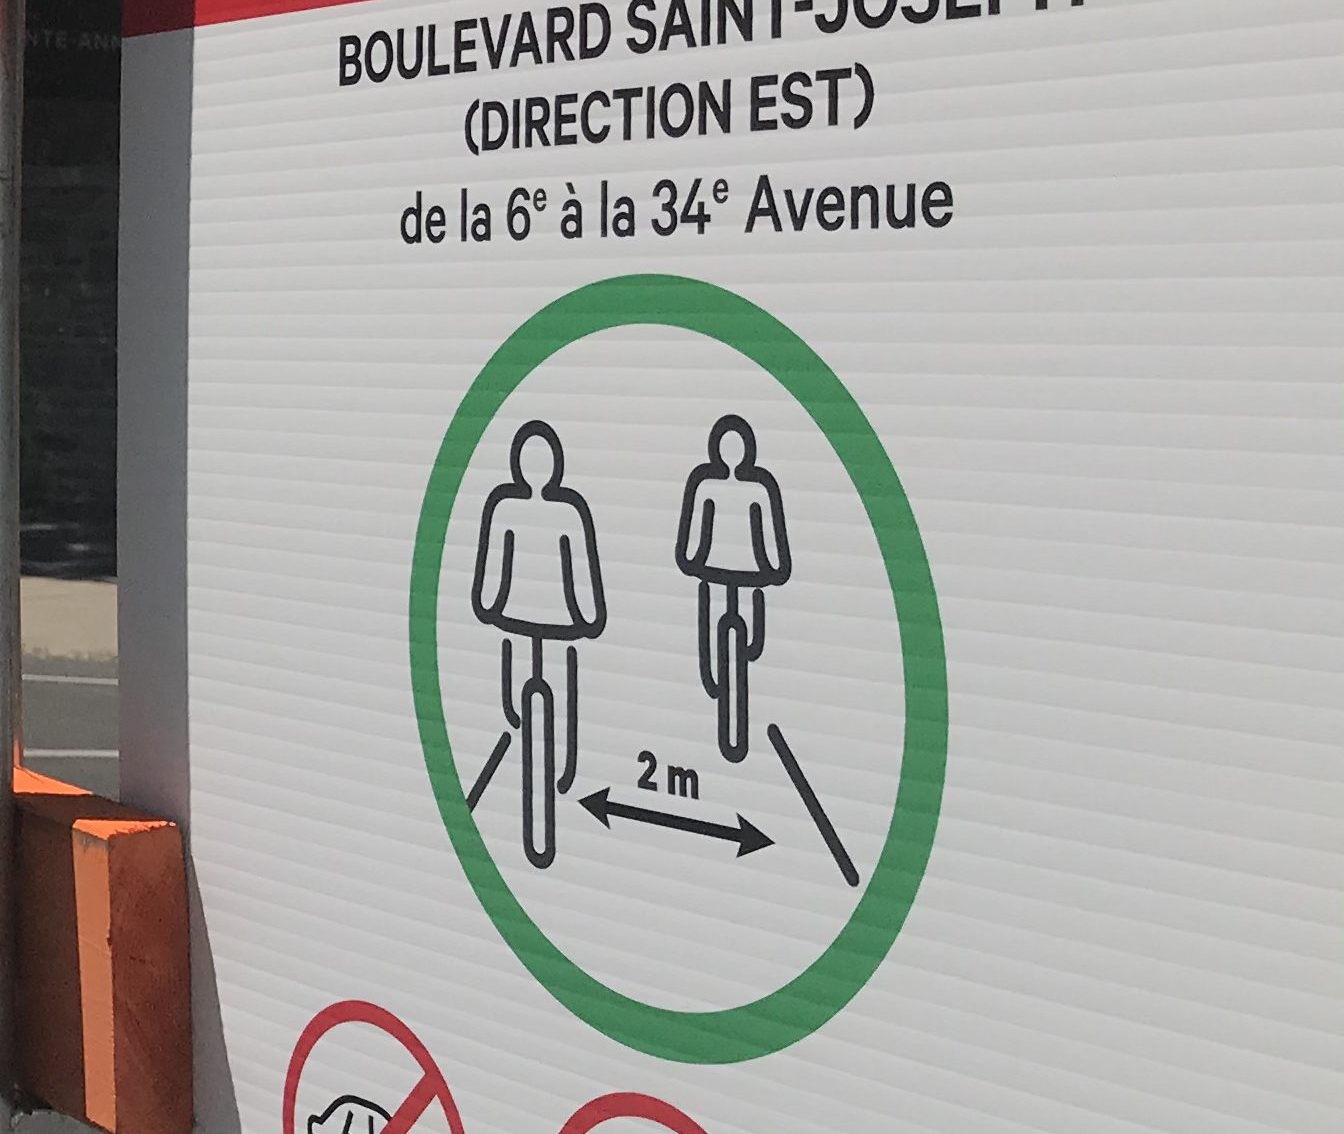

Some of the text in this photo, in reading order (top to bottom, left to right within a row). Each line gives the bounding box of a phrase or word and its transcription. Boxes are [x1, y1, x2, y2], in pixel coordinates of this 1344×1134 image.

[340, 3, 611, 86] BOULEVARD
[465, 62, 874, 155] (DIRECTION EST)
[401, 191, 445, 244] de
[461, 188, 491, 241] la
[561, 183, 582, 239] à
[601, 180, 635, 237] la
[745, 175, 953, 232] Avenue
[638, 751, 699, 799] 2 m
